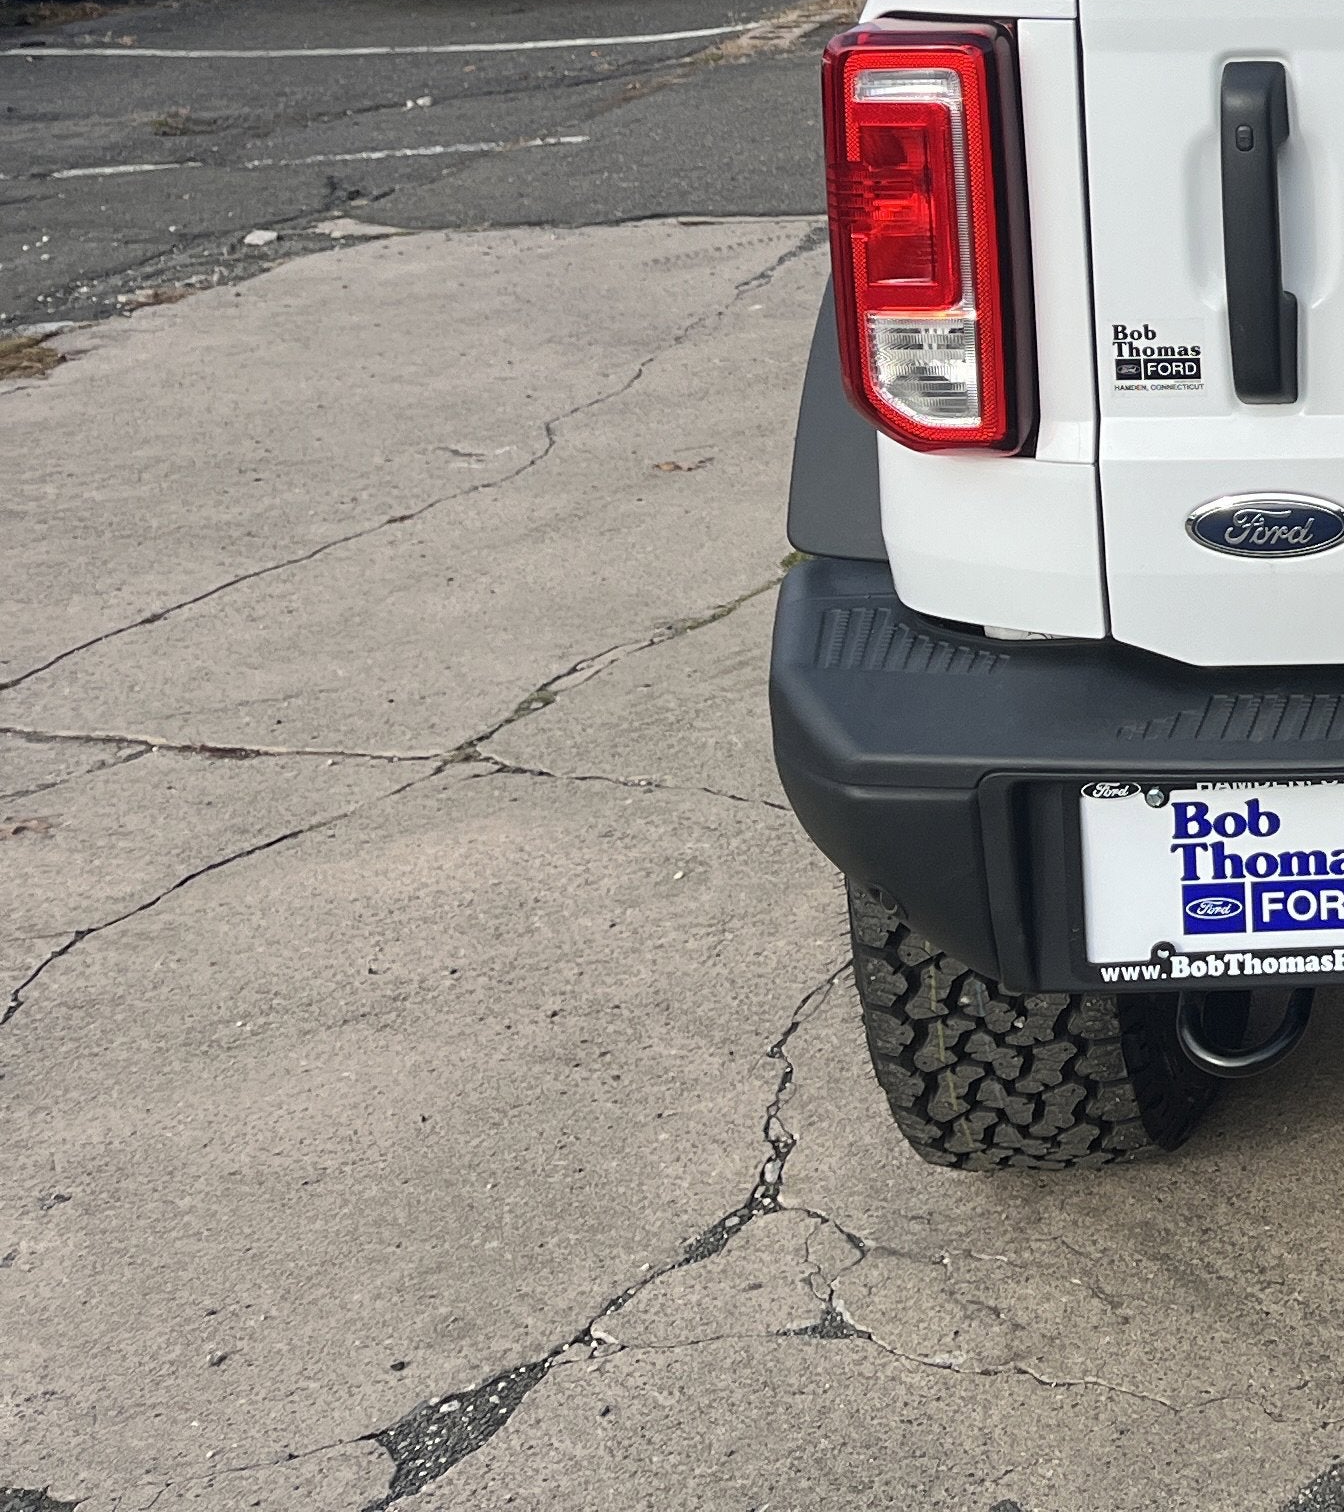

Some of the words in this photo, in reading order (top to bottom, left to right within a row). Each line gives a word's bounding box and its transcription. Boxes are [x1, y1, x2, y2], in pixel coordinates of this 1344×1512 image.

[1111, 323, 1157, 341] Bob
[1111, 341, 1202, 358] Thomas
[1147, 362, 1197, 376] FORD
[1225, 508, 1315, 545] Ford
[1091, 783, 1130, 797] Ford
[1171, 798, 1281, 840] Bob
[1195, 901, 1234, 916] Ford
